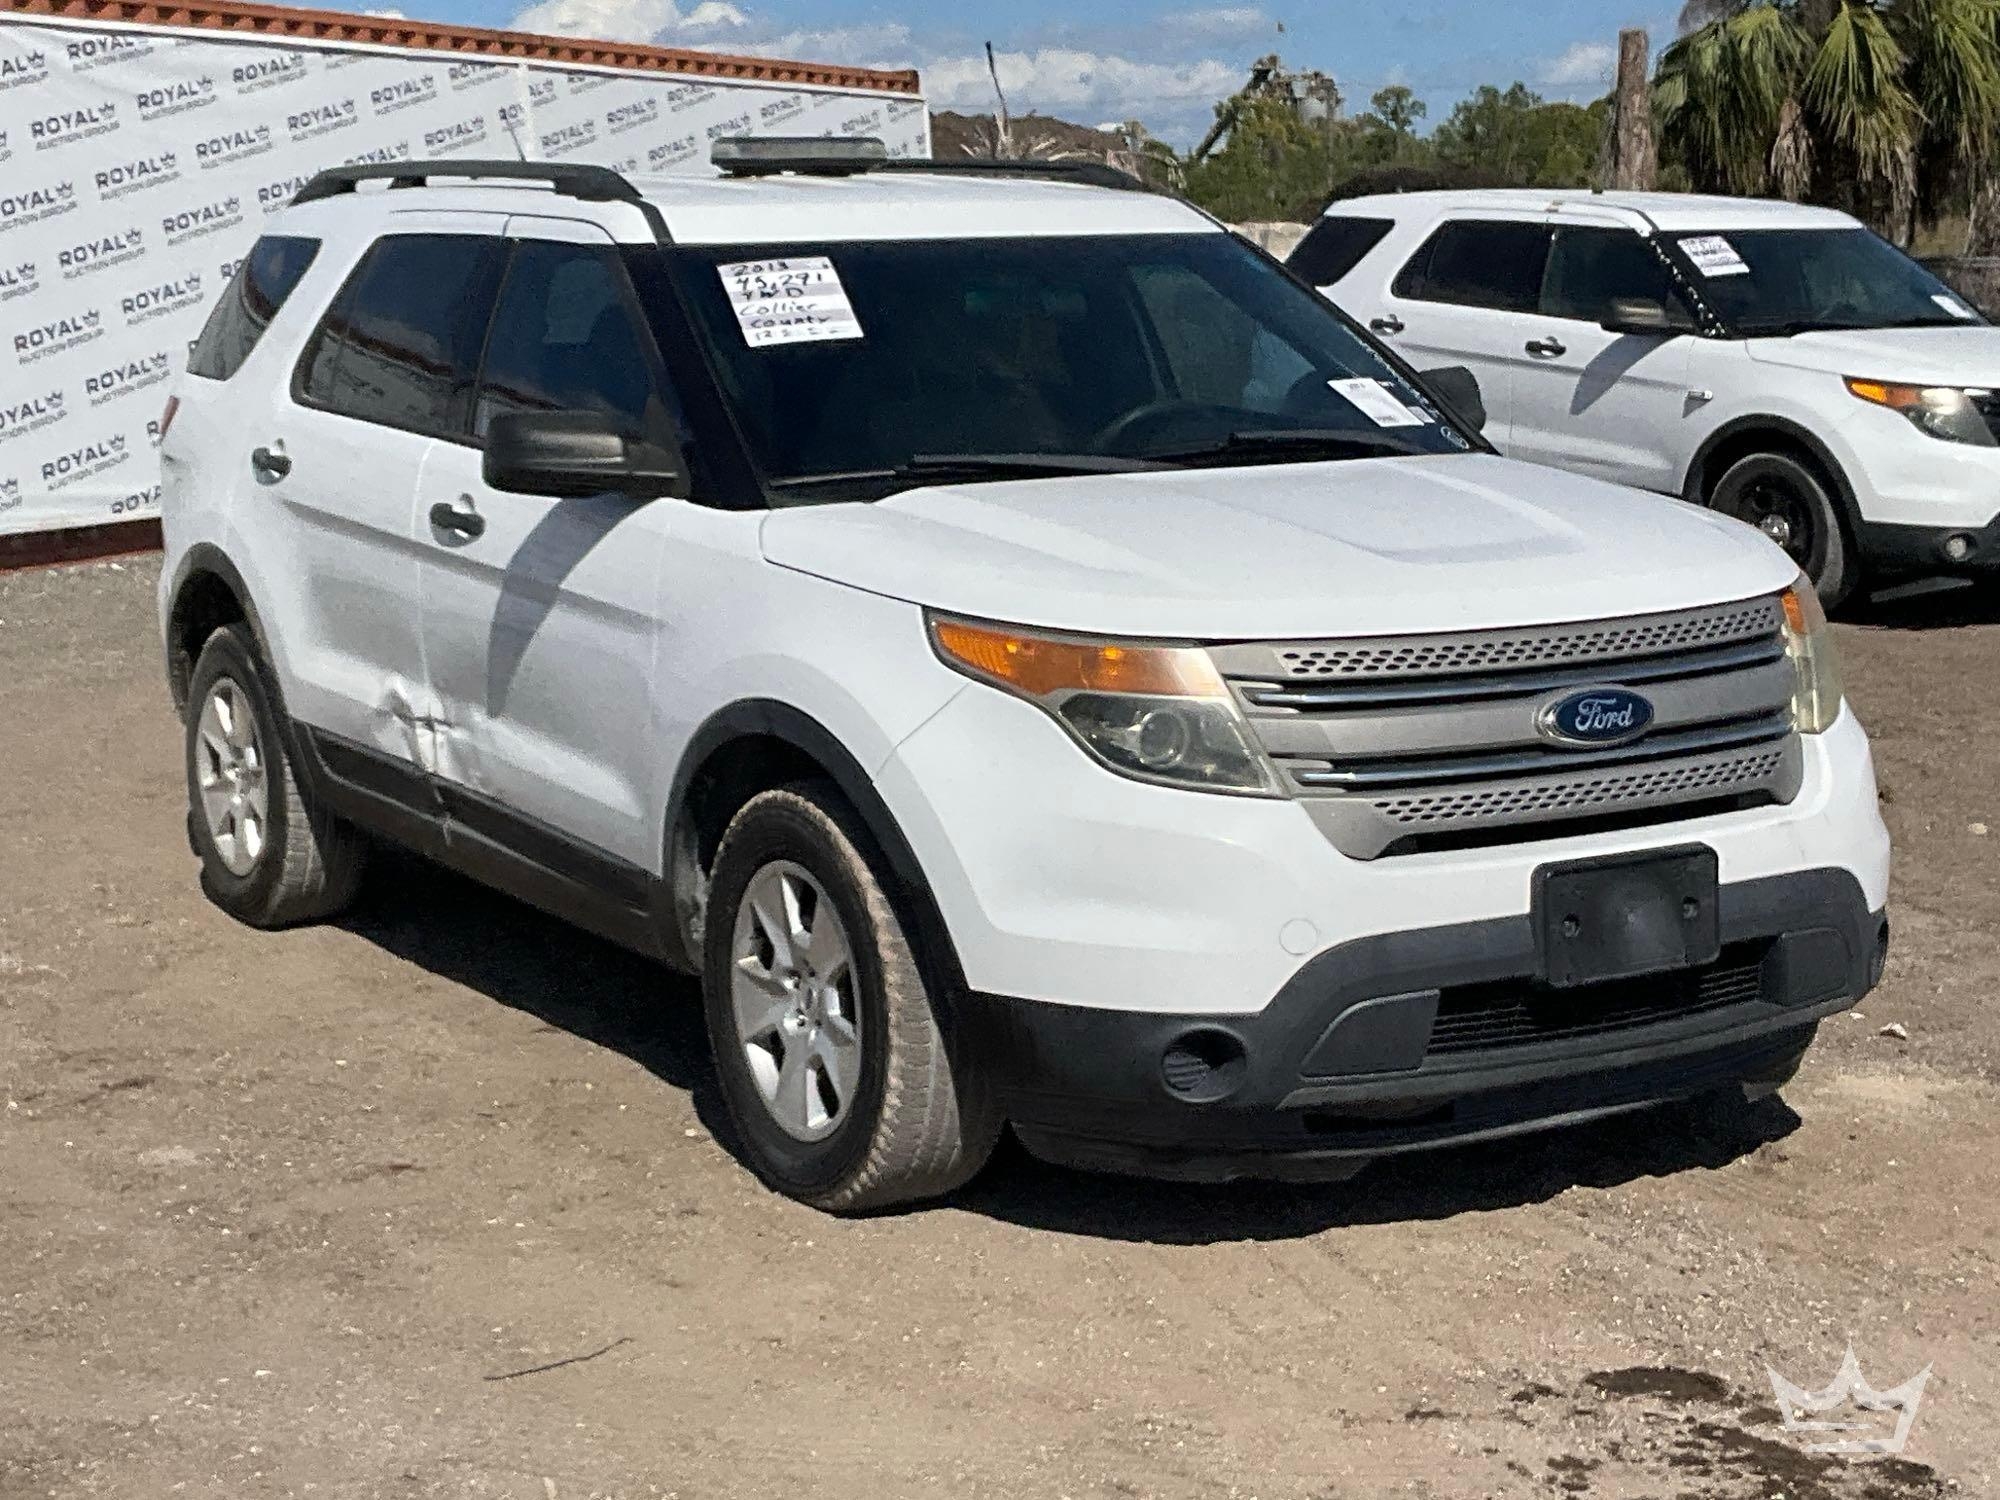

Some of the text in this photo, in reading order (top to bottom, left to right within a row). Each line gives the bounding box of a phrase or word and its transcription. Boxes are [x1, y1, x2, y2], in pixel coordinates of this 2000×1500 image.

[232, 57, 291, 83] ROYAL
[137, 80, 199, 109] ROYAL
[371, 80, 421, 104] ROYAL
[31, 108, 100, 138] ROYAL
[287, 104, 343, 131] ROYAL
[195, 130, 256, 158] ROYAL
[424, 121, 473, 147] ROYAL
[542, 126, 584, 149] ROYAL
[95, 158, 161, 188] ROYAL
[163, 203, 225, 234] ROYAL
[59, 235, 127, 267] ROYAL
[122, 281, 186, 314] ROYAL
[14, 317, 83, 353] ROYAL
[86, 358, 151, 395] ROYAL
[42, 442, 110, 480] ROYAL
[1575, 697, 1634, 732] Ford
